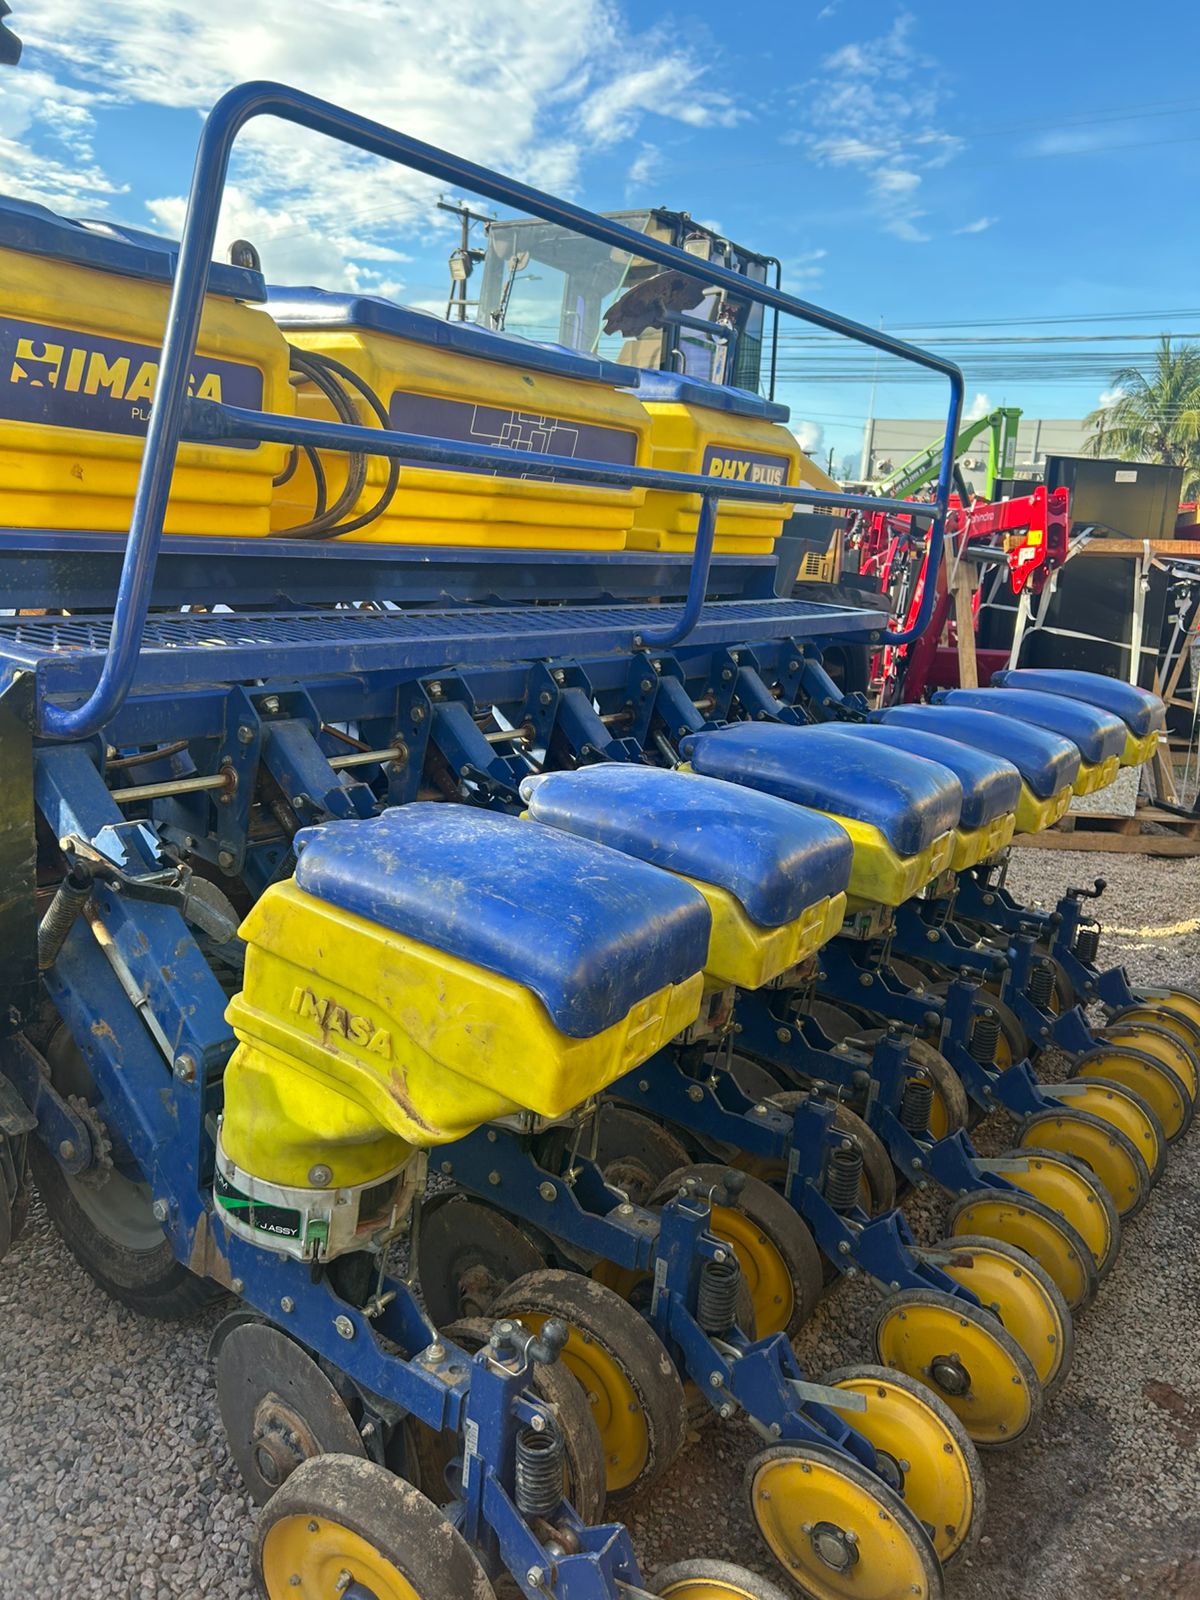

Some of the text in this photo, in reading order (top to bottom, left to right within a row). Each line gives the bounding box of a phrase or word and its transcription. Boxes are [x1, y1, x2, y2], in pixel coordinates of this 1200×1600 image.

[708, 457, 781, 486] PHX PLUS
[289, 986, 392, 1059] IMASA
